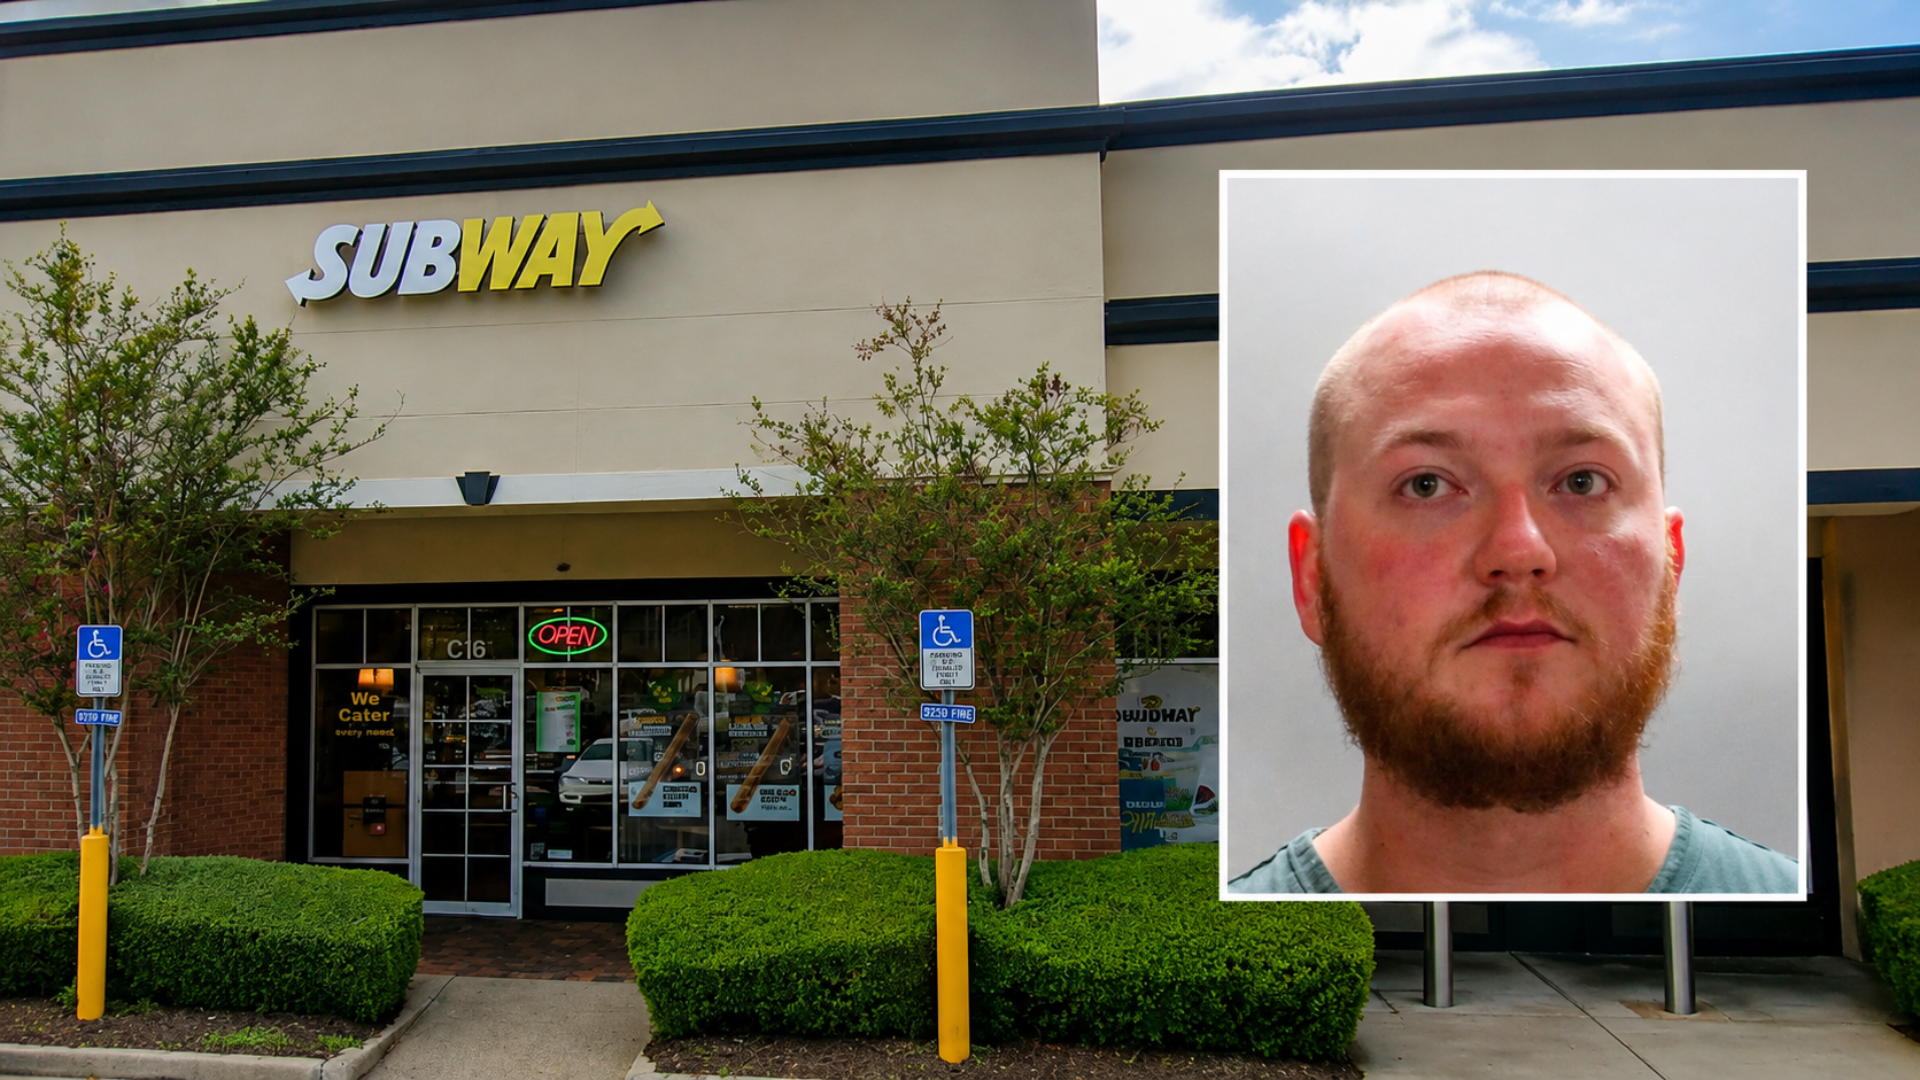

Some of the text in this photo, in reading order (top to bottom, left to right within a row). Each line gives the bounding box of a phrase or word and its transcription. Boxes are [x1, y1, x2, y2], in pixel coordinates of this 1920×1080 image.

[285, 200, 665, 307] SUBWAY
[538, 624, 598, 648] OPEN
[447, 639, 487, 660] C16
[351, 692, 380, 706] We
[338, 708, 390, 722] Cater
